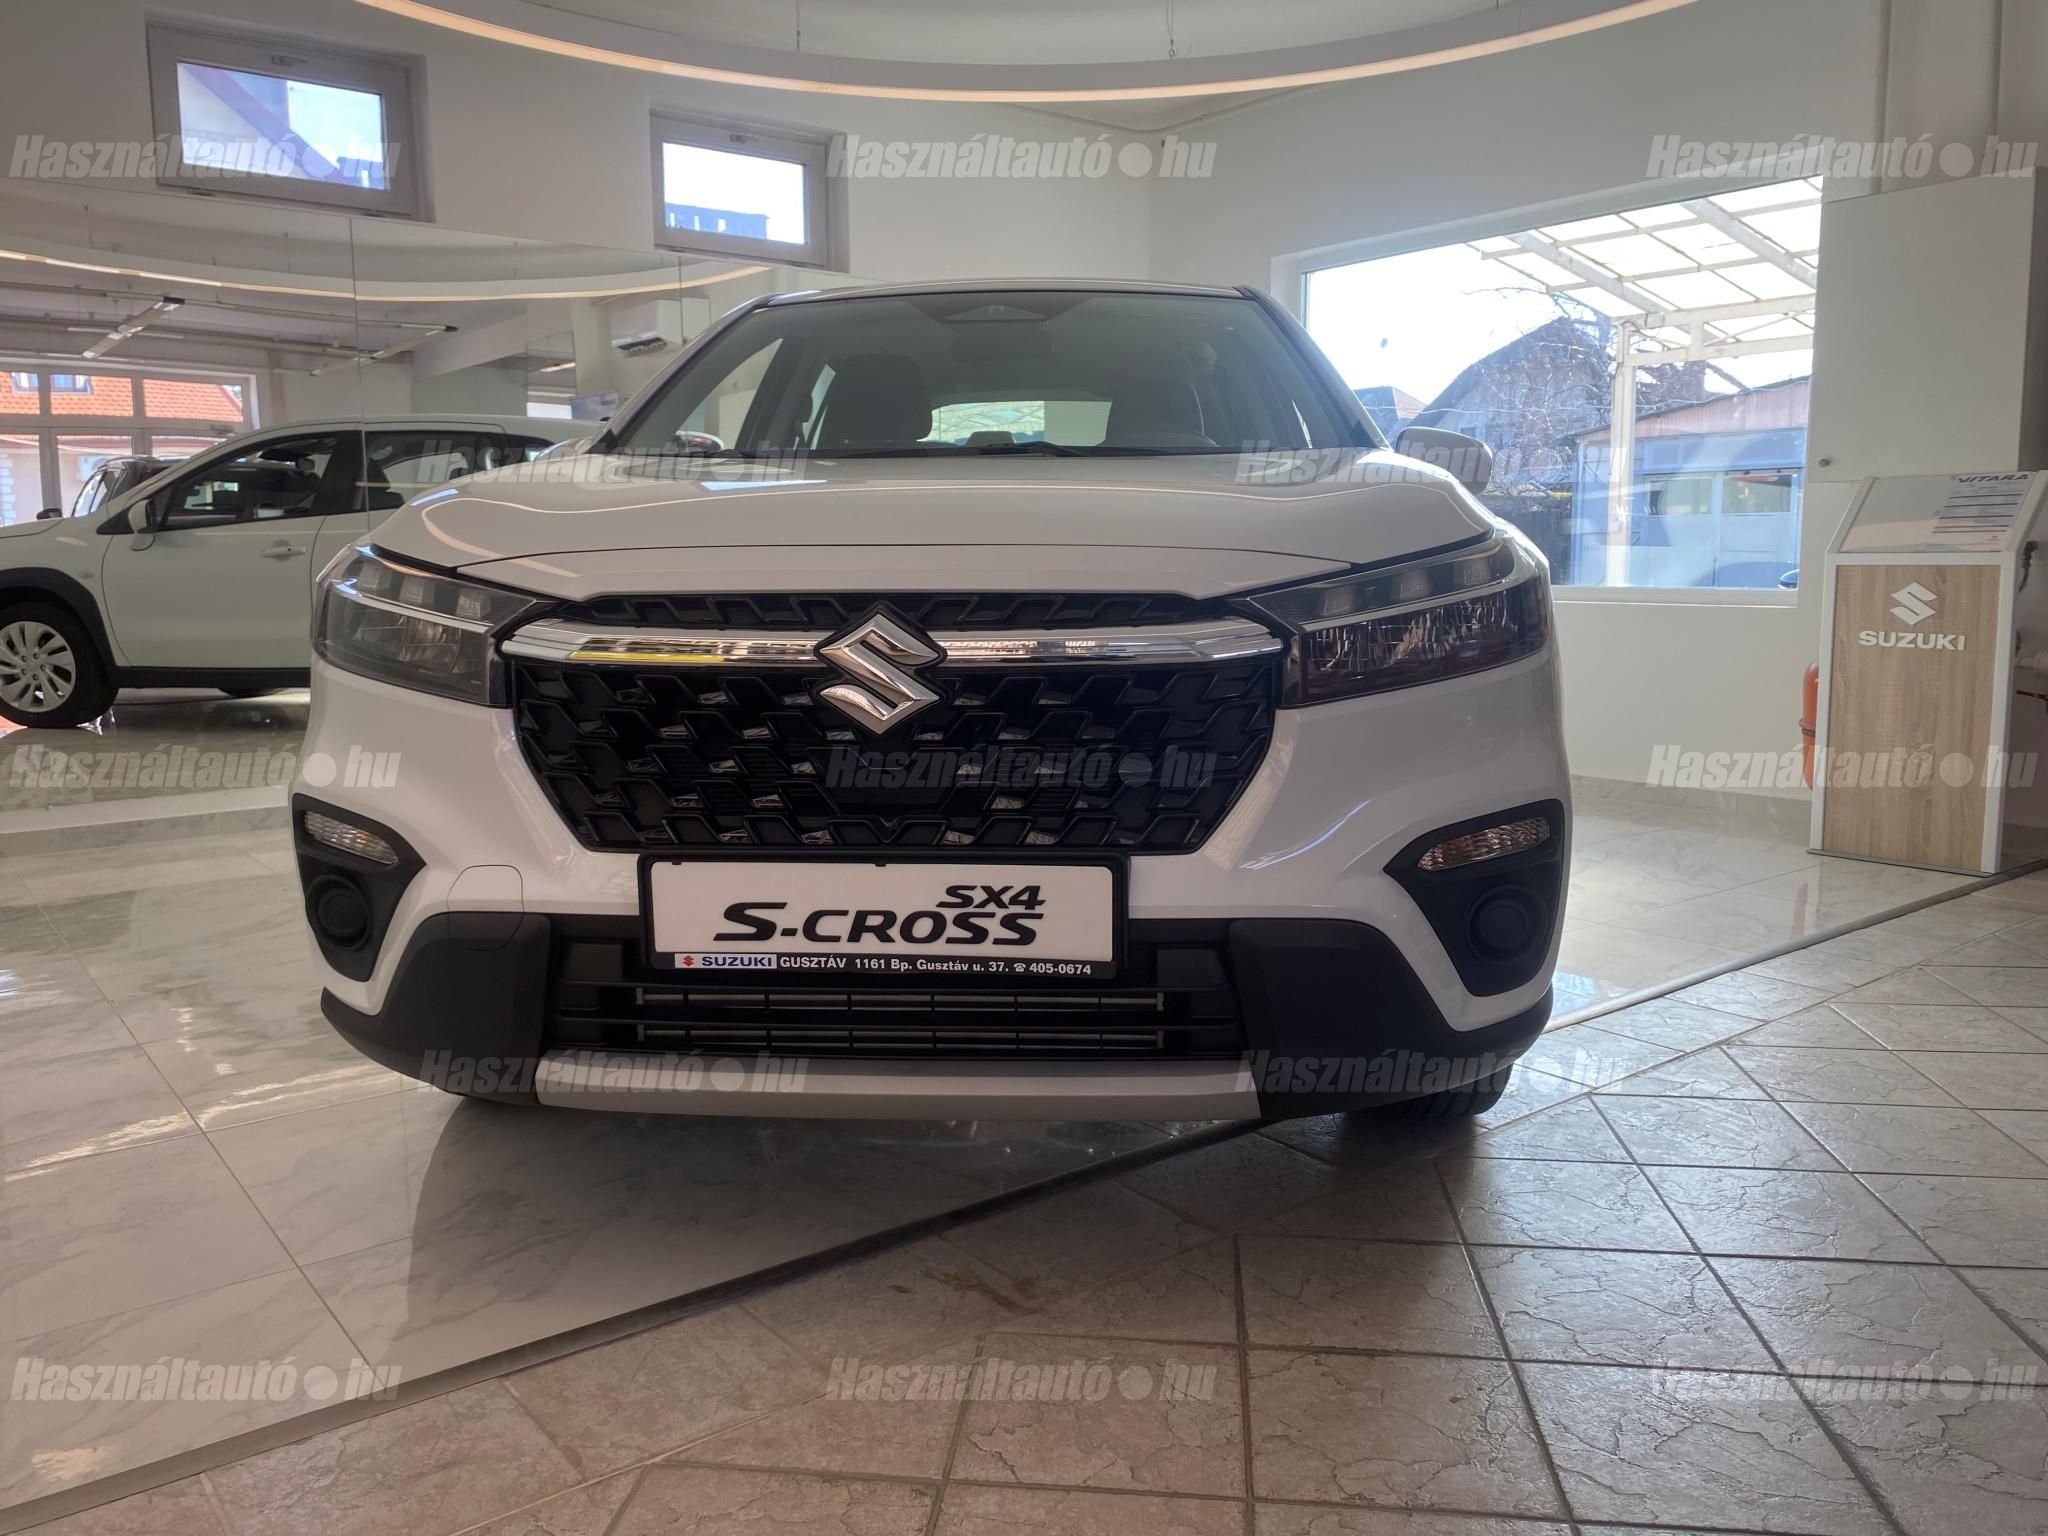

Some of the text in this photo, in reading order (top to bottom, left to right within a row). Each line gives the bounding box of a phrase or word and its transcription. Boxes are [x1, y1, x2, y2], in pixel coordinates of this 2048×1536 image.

[1958, 474, 2028, 483] VITARA
[1858, 631, 1966, 650] SUZUKI
[935, 884, 1046, 910] SX4
[713, 902, 1044, 946] S-CROSS
[702, 955, 1091, 975] SUZUKI GUSZTÁV 1161 Bp. Gusztáv u. 37. 405-0674
